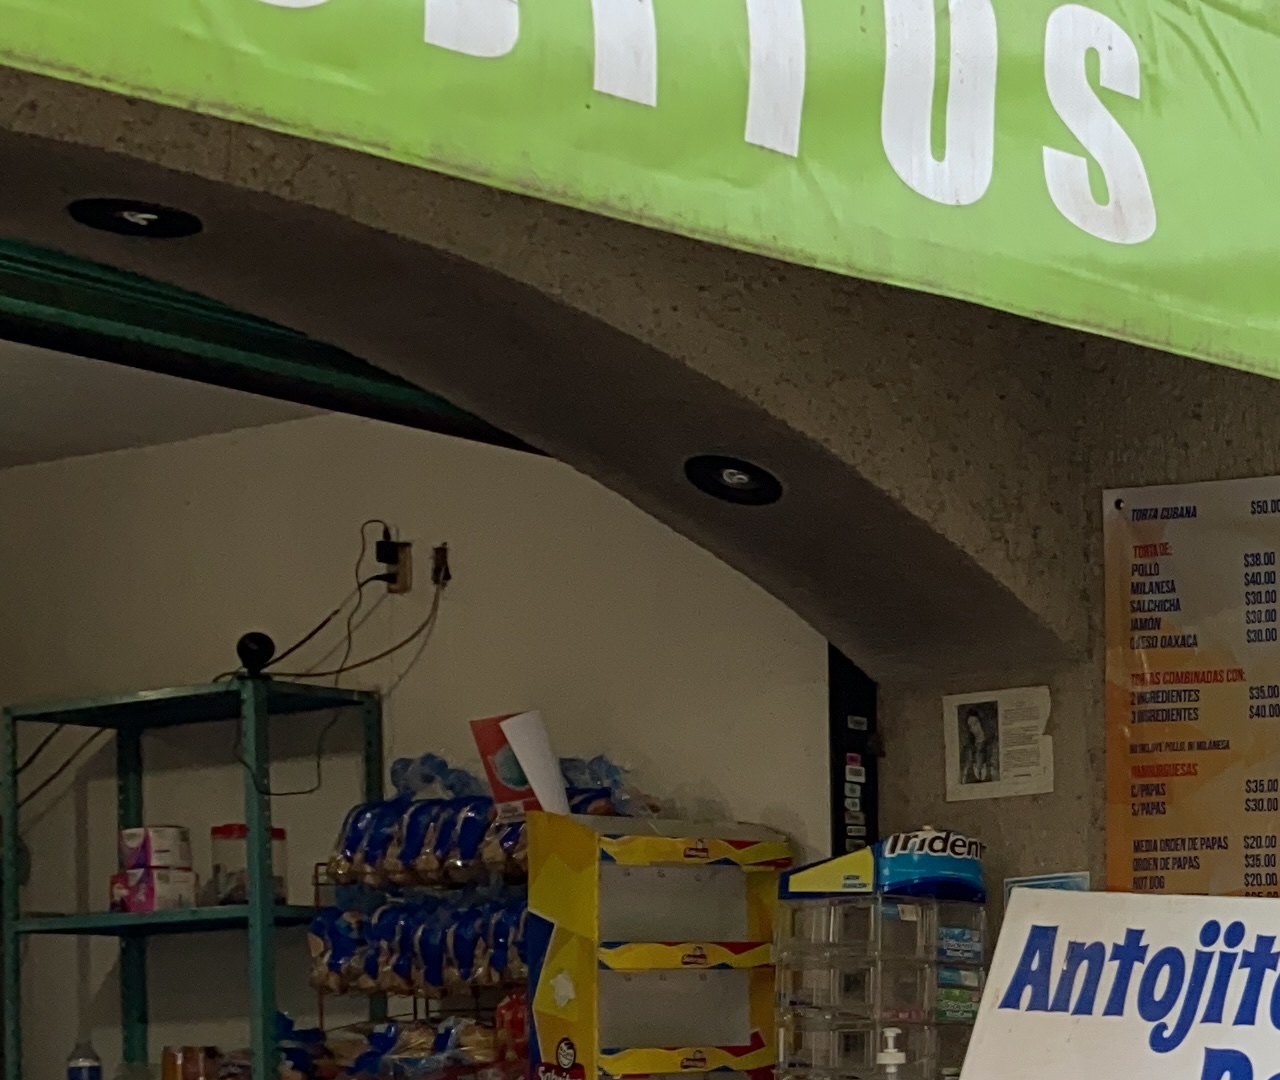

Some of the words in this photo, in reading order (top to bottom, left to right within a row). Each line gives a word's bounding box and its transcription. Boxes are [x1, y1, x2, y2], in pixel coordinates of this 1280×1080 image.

[1132, 508, 1158, 521] TORTA
[1244, 551, 1275, 568] $38.00
[1130, 580, 1177, 595] MILANESA
[1244, 571, 1276, 587] $40.00
[1130, 598, 1181, 613] SALCHICHA
[1245, 590, 1277, 606] $30.00
[1245, 608, 1277, 625] $30.00
[1160, 634, 1198, 649] OAXACA
[1246, 627, 1277, 644] $30.00
[1162, 669, 1225, 685] COMBINADAS
[1248, 684, 1280, 701] $35.00
[1248, 703, 1280, 719] $40.00
[1245, 778, 1279, 794] $35.00
[1244, 797, 1279, 812] $30.00
[1200, 836, 1228, 850] PAPAS
[1243, 835, 1277, 849] $20.00
[1171, 855, 1200, 870] PAPAS
[1244, 853, 1277, 868] $35.00
[1244, 872, 1278, 887] $20.00
